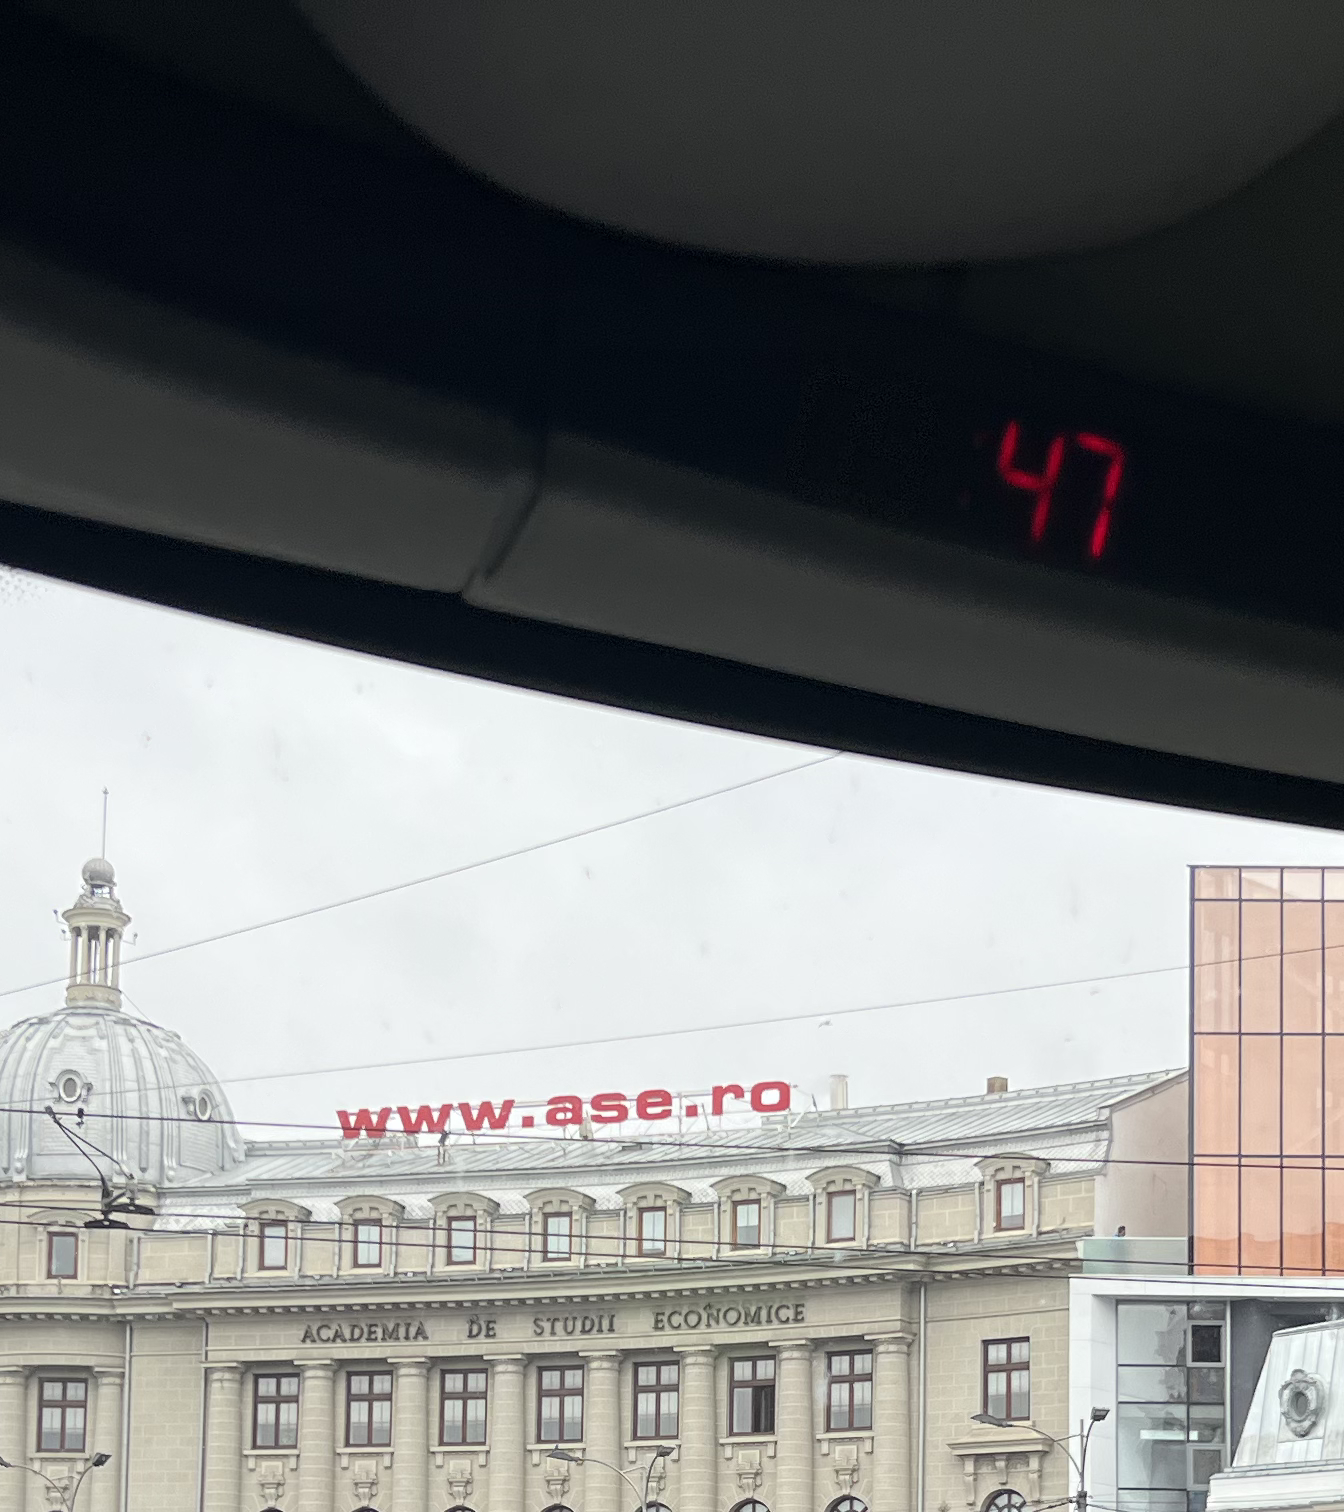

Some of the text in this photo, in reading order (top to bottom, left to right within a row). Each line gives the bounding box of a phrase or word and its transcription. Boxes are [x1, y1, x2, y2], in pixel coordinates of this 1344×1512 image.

[996, 420, 1126, 560] 47
[335, 1080, 791, 1139] www.ase.ro
[301, 1303, 806, 1345] ACADEMIA DE STUDII ECONOMICE
